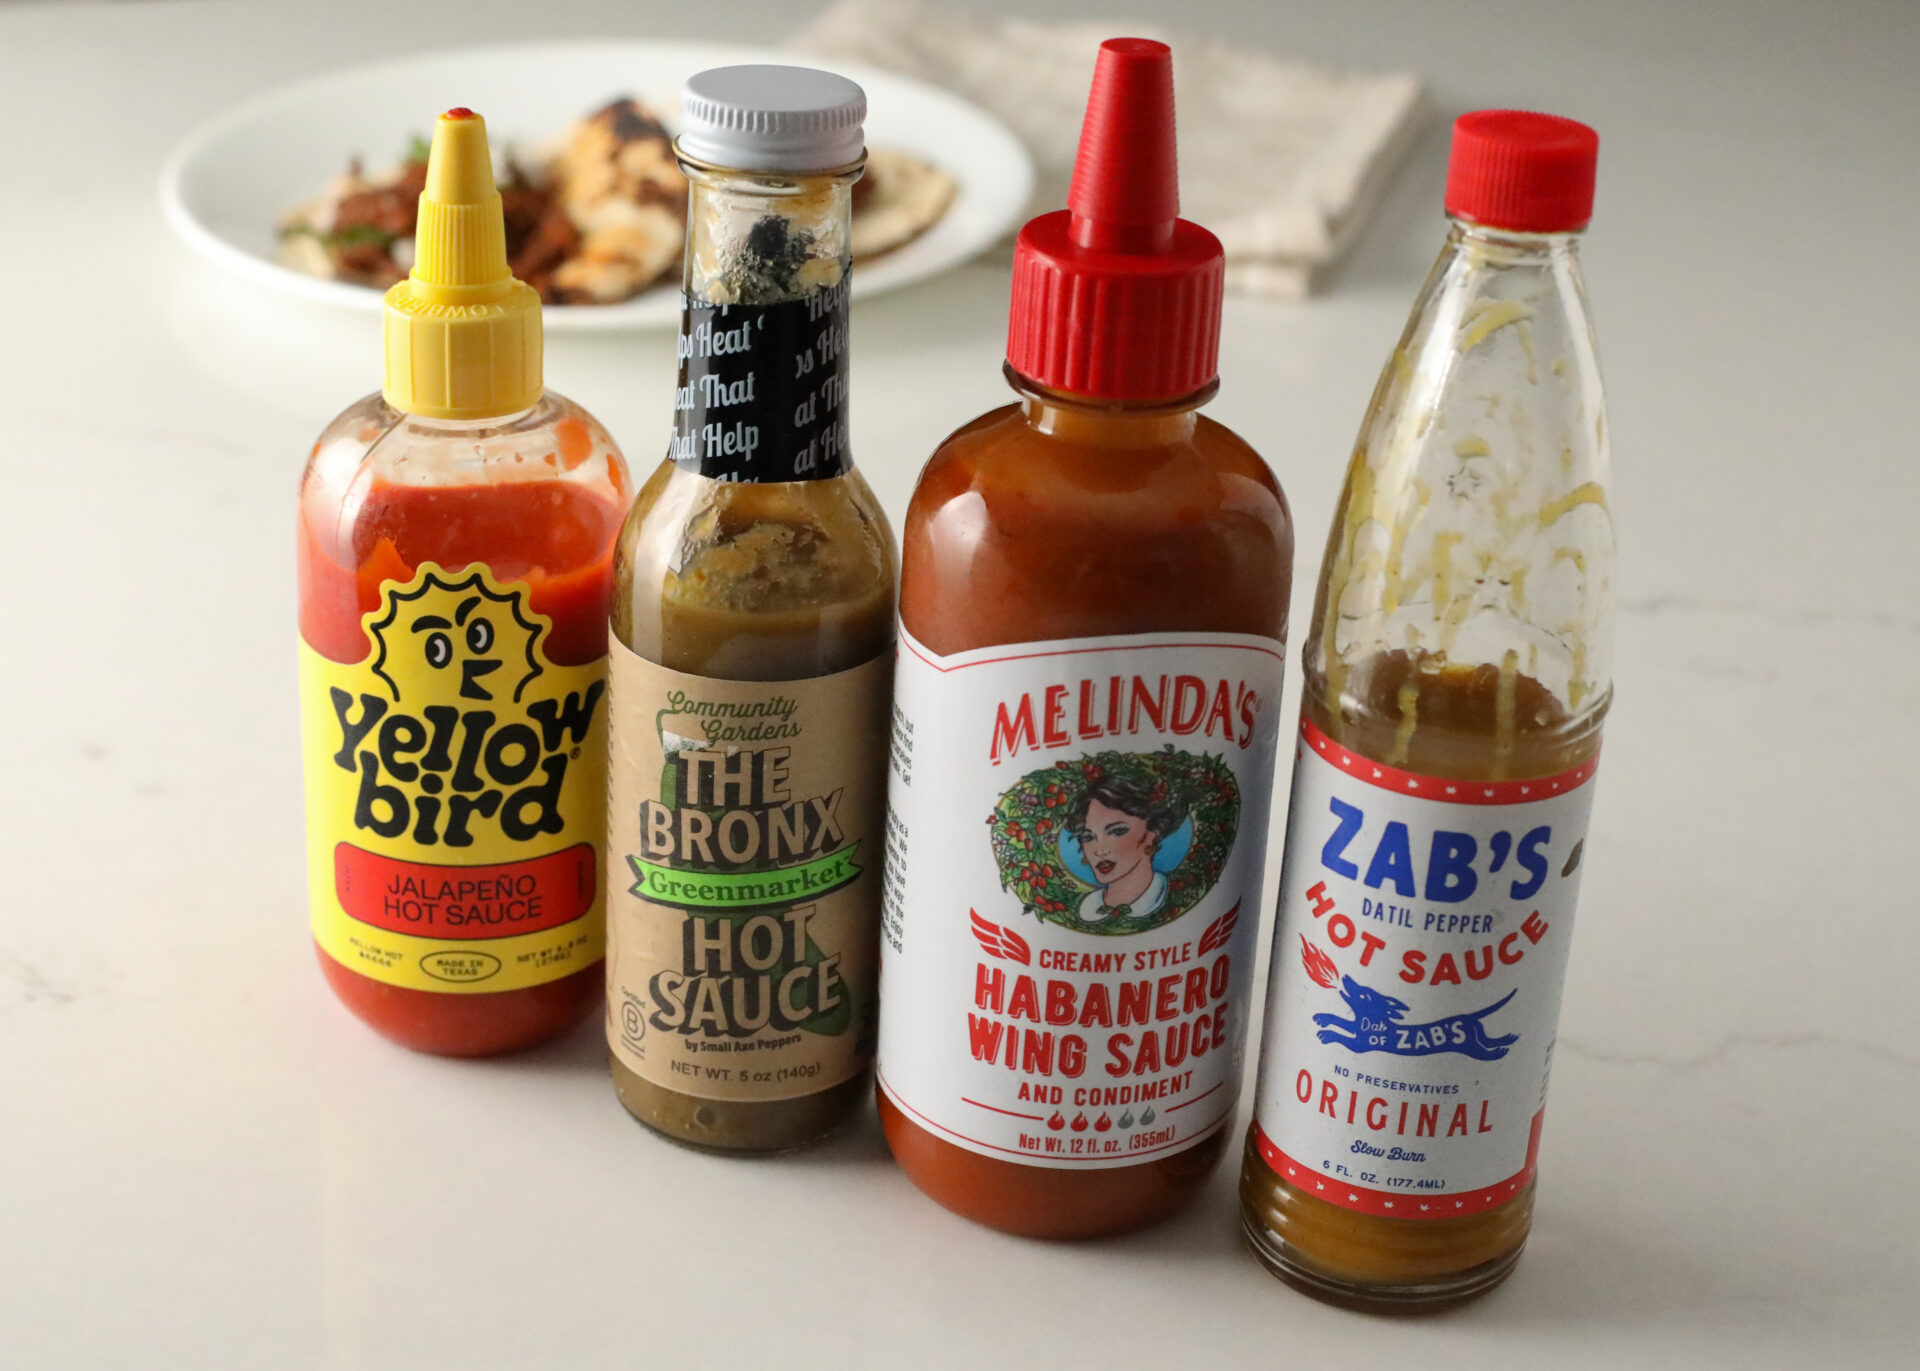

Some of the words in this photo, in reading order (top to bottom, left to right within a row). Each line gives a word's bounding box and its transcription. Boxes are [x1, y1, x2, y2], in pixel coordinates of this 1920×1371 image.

[696, 320, 751, 357] Heat
[675, 380, 695, 410] eat
[700, 372, 755, 408] That
[702, 421, 759, 462] Help
[667, 690, 799, 722] Community
[990, 674, 1257, 766] MELINDA'S
[330, 678, 605, 792] Yellow
[701, 719, 802, 747] Gardens
[673, 746, 791, 806] THE
[354, 751, 568, 847] bird
[640, 787, 845, 866] BRONX
[1321, 795, 1552, 904] ZAB'S
[388, 874, 536, 901] JALAPEÑO
[649, 860, 845, 901] Greenmarket
[384, 896, 439, 924] HOT
[446, 896, 541, 926] SAUCE
[1362, 898, 1413, 928] DATIL
[1424, 912, 1494, 934] PEPPER
[683, 904, 816, 976] HOT
[1305, 880, 1387, 968] HOT
[1398, 909, 1550, 986] SAUCE
[437, 959, 467, 968] MADE
[469, 959, 483, 968] IN
[443, 967, 478, 976] TEXAS
[1039, 949, 1127, 973] CREAMY
[1134, 942, 1192, 971] STYLE
[649, 952, 841, 1036] SAUCE
[975, 953, 1230, 1027] HABANERO
[968, 1012, 1088, 1079] WING
[1105, 1002, 1229, 1077] SAUCE
[1360, 1017, 1389, 1032] Dab
[1368, 1035, 1387, 1047] OF
[1396, 1020, 1467, 1049] ZAB'S
[685, 1038, 699, 1052] by
[701, 1041, 732, 1053] Small
[734, 1042, 755, 1052] Axe
[757, 1034, 802, 1051] Peppers
[671, 1060, 701, 1077] NET
[706, 1068, 733, 1082] WT.
[739, 1071, 749, 1083] 5
[753, 1071, 771, 1082] oz
[776, 1062, 821, 1083] (140g)
[1018, 1082, 1063, 1105] AND
[1074, 1070, 1193, 1106] CONDIMENT
[1334, 1064, 1350, 1078] NO
[1356, 1072, 1460, 1094] PRESERVATIVES
[1296, 1068, 1494, 1138] ORIGINAL
[1019, 1133, 1041, 1151] Net
[1045, 1136, 1066, 1153] Wt.
[1070, 1138, 1083, 1154] 12
[1087, 1138, 1100, 1154] fl.
[1104, 1139, 1121, 1153] oz.
[1350, 1139, 1386, 1157] Slow
[1387, 1146, 1426, 1163] Burn
[1322, 1160, 1330, 1170] 6
[1336, 1164, 1353, 1178] FL.
[1361, 1171, 1379, 1184] OZ.
[1387, 1177, 1446, 1190] (177.4ML)
